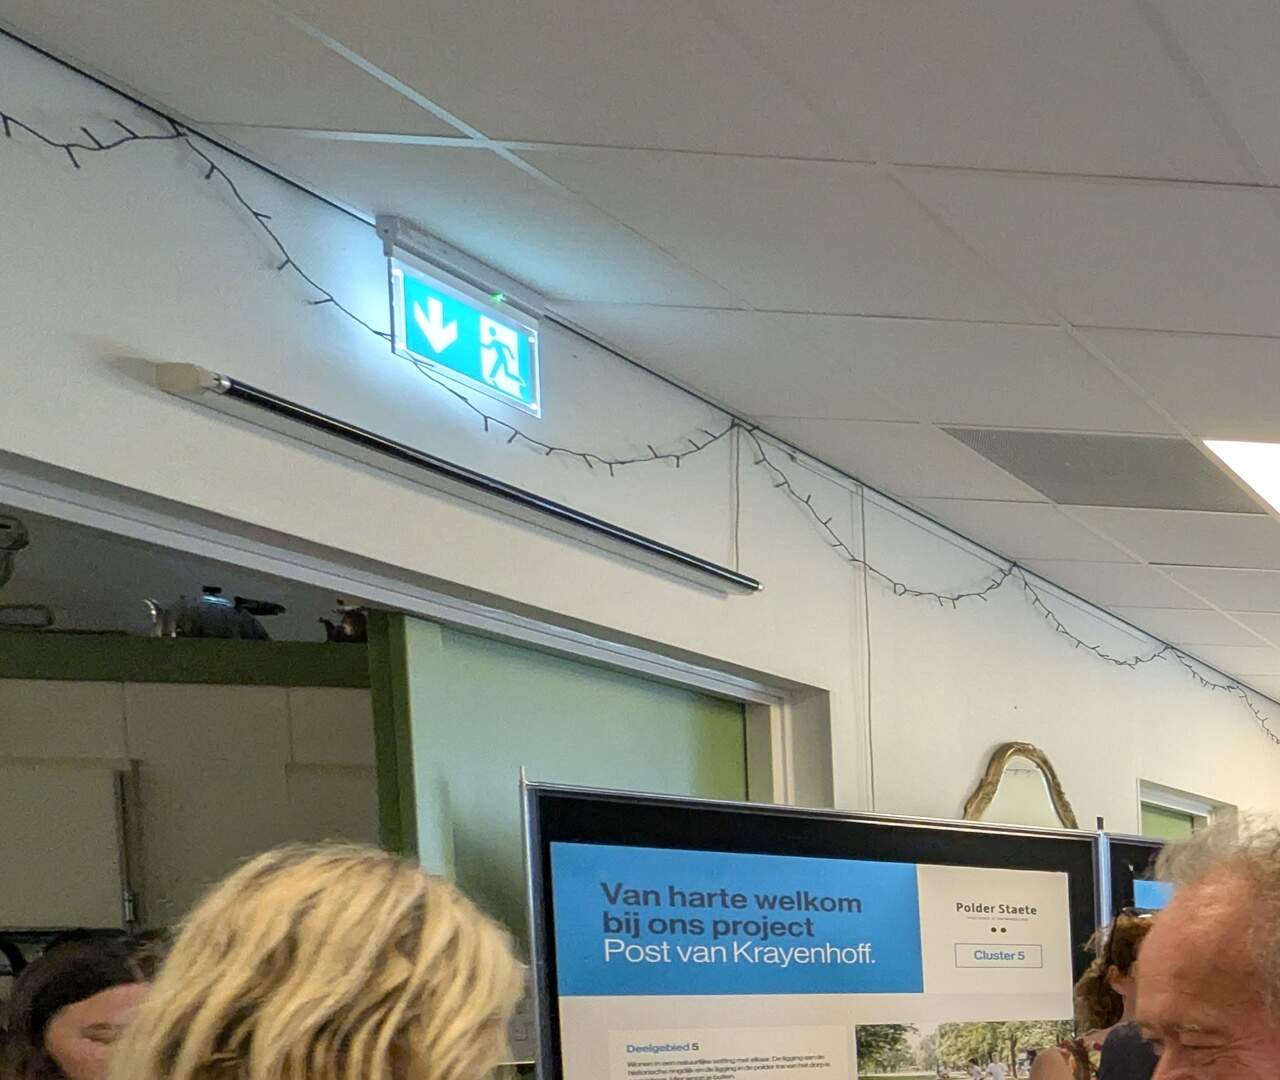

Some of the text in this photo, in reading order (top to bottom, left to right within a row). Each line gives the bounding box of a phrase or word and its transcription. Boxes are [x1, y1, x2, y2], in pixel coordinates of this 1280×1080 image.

[601, 883, 862, 913] Van harte welkom
[956, 902, 1037, 915] Polder Staete
[603, 911, 815, 941] bij ons project
[604, 939, 876, 967] Post van Krayenhoff.
[974, 950, 1016, 960] Cluster
[627, 1043, 690, 1054] Deelgebied
